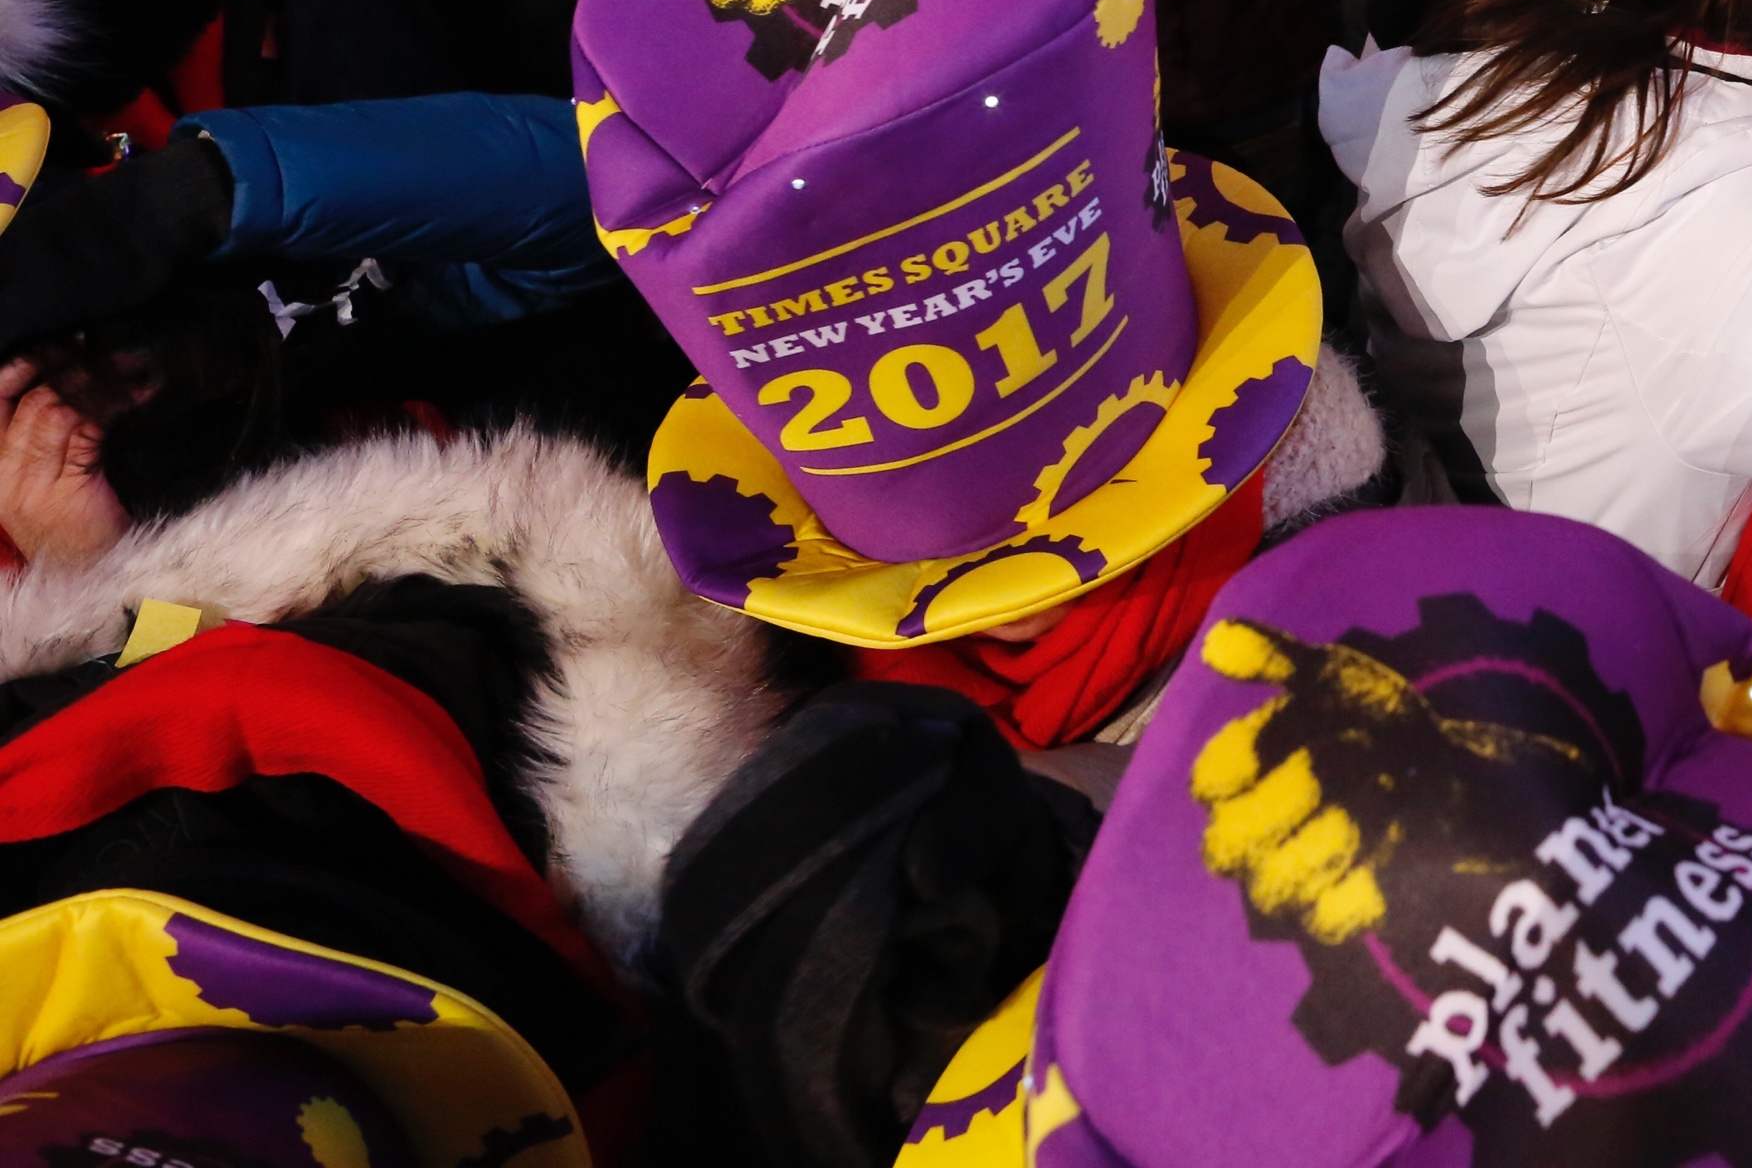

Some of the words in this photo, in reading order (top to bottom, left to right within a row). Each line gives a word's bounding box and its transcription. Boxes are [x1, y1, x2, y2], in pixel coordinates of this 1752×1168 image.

[707, 266, 895, 337] TIMES
[899, 158, 1097, 286] SQUARE
[728, 320, 850, 369] NEW
[854, 258, 1026, 336] YEAR'S
[1025, 196, 1103, 269] EVE
[756, 230, 1116, 452] 2017
